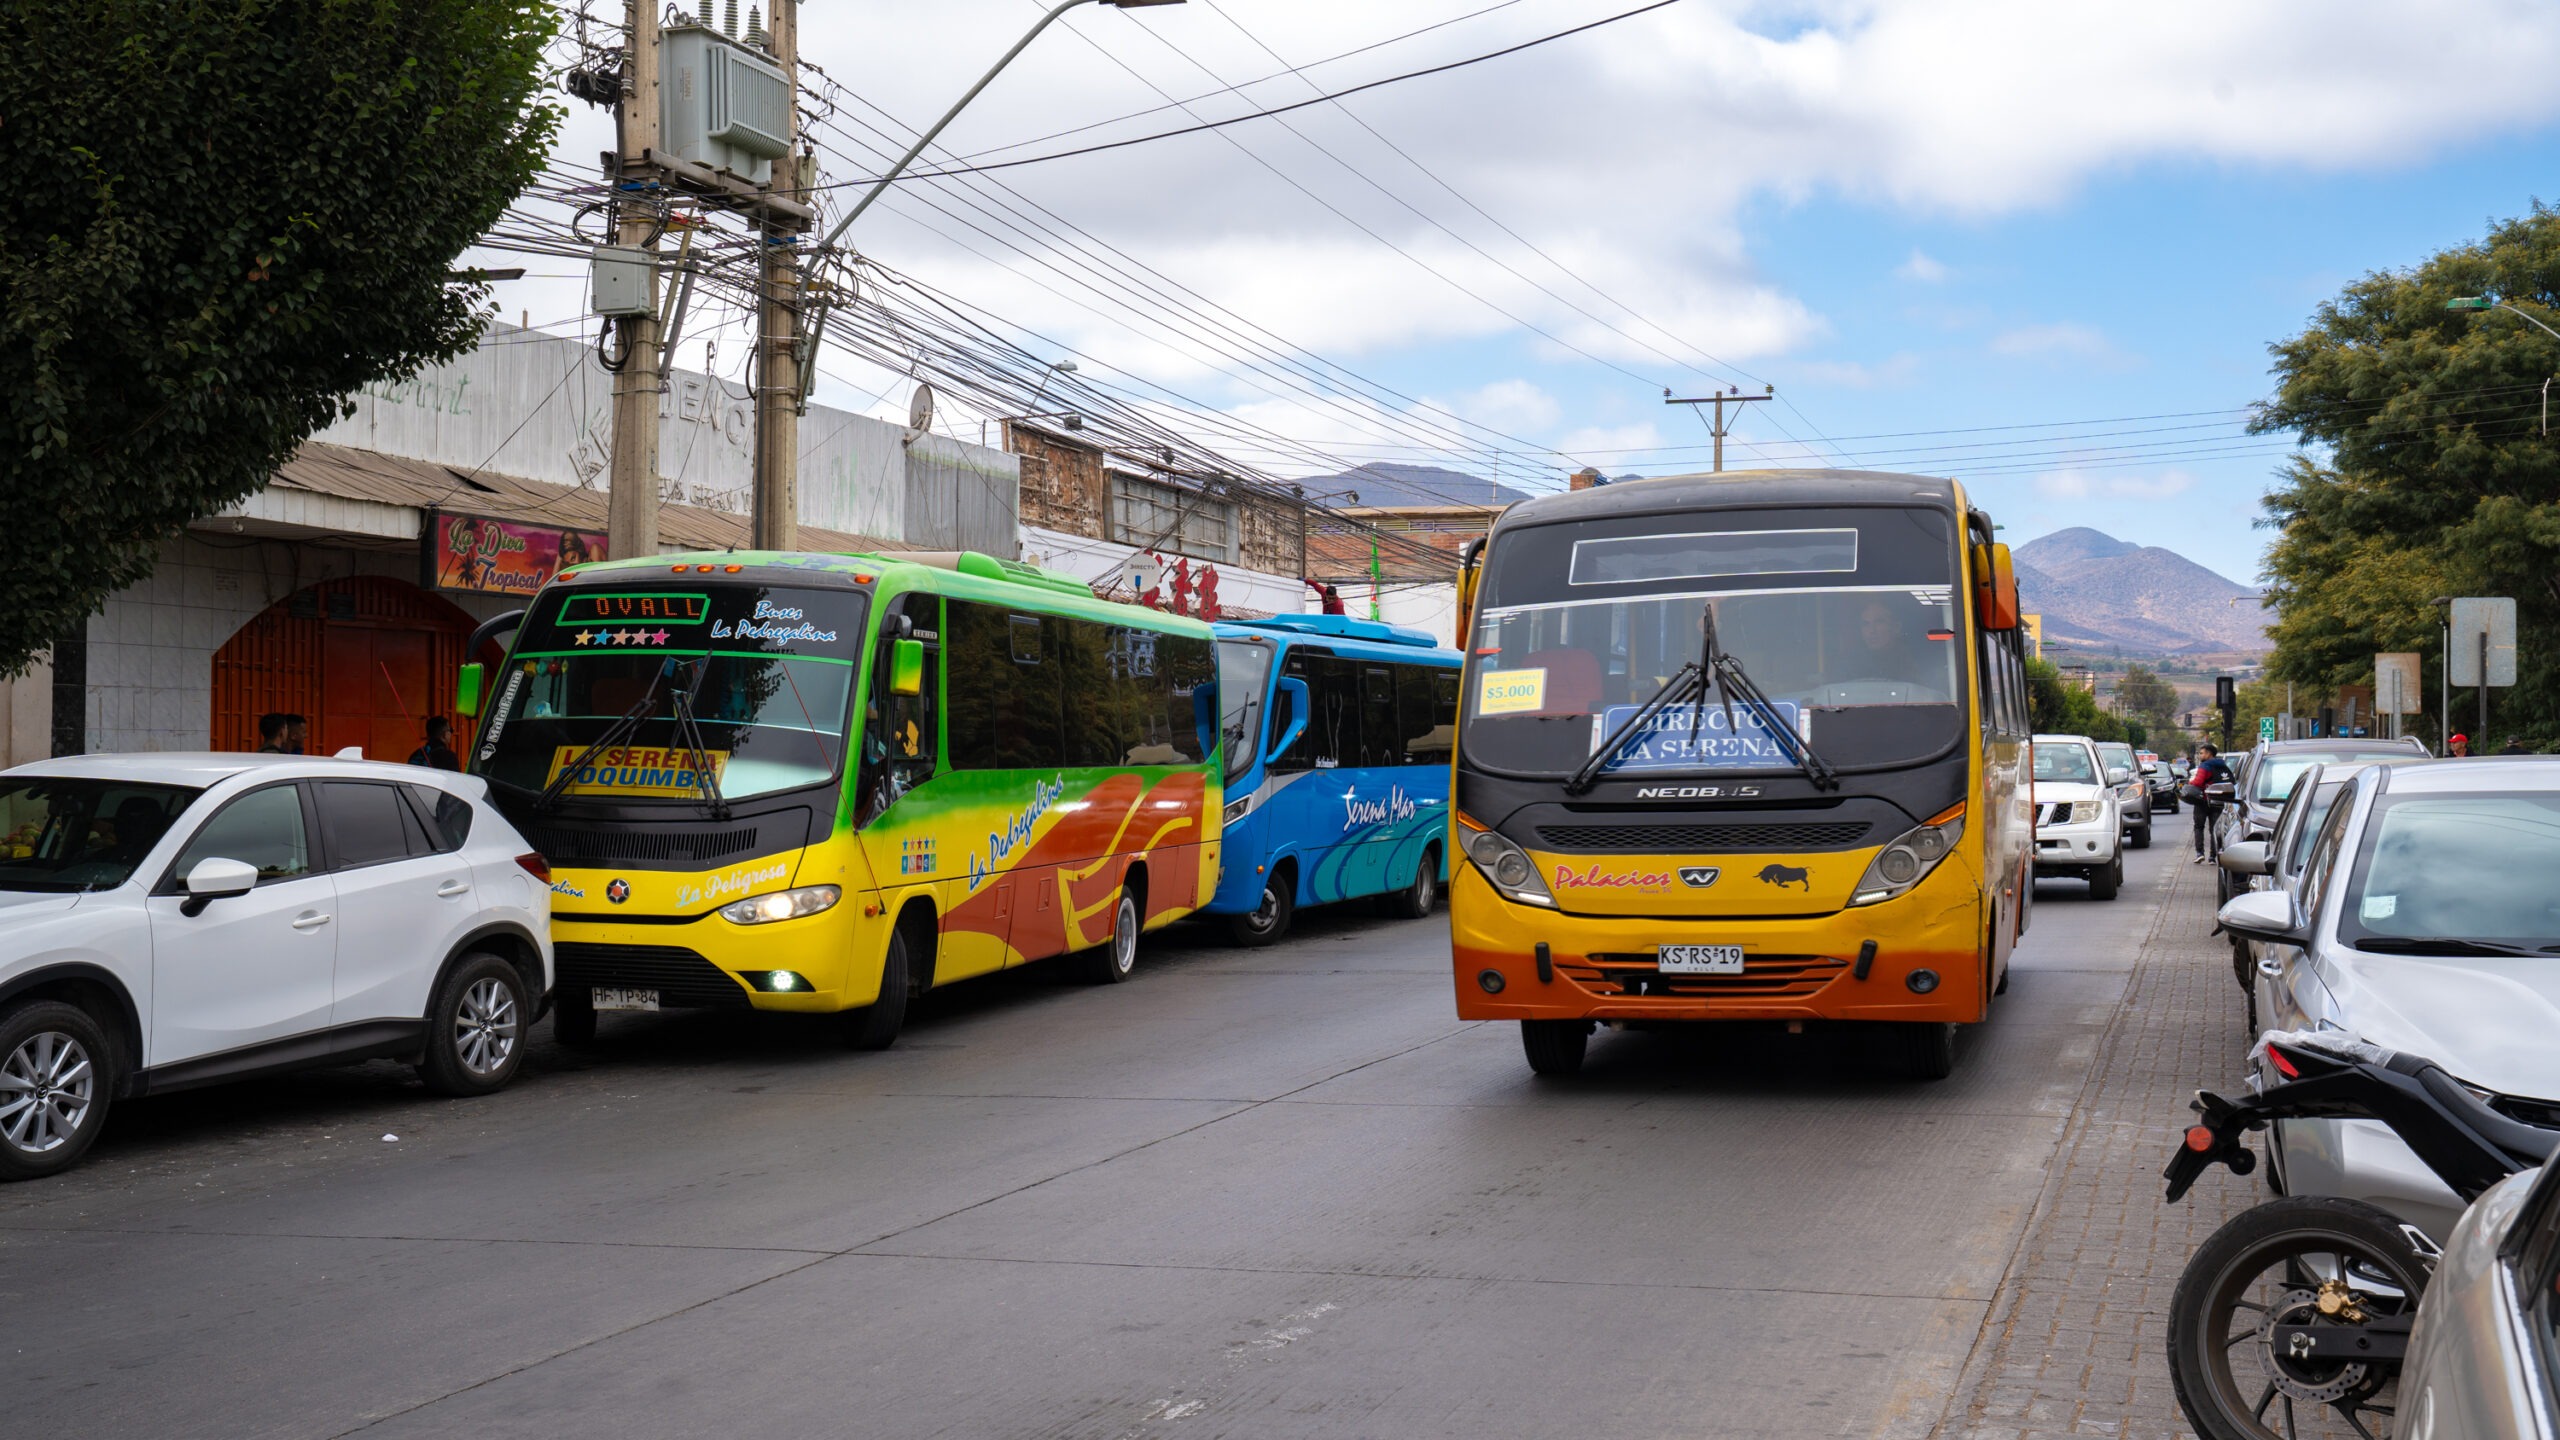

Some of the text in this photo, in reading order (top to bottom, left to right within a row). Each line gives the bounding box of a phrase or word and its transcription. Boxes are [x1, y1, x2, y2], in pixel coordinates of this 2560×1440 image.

[449, 517, 526, 558] La Diva
[474, 557, 544, 591] Tropical
[754, 599, 803, 620] Buses
[710, 619, 837, 647] La Pedregalina
[1487, 684, 1535, 699] $5.000
[605, 749, 717, 771] SERENA
[1614, 737, 1785, 761] LA SERENA
[1343, 783, 1416, 832] Serena Mar
[969, 773, 1063, 893] La Pedregalina
[675, 862, 788, 909] La Peligrosa
[1554, 863, 1671, 891] Palacios
